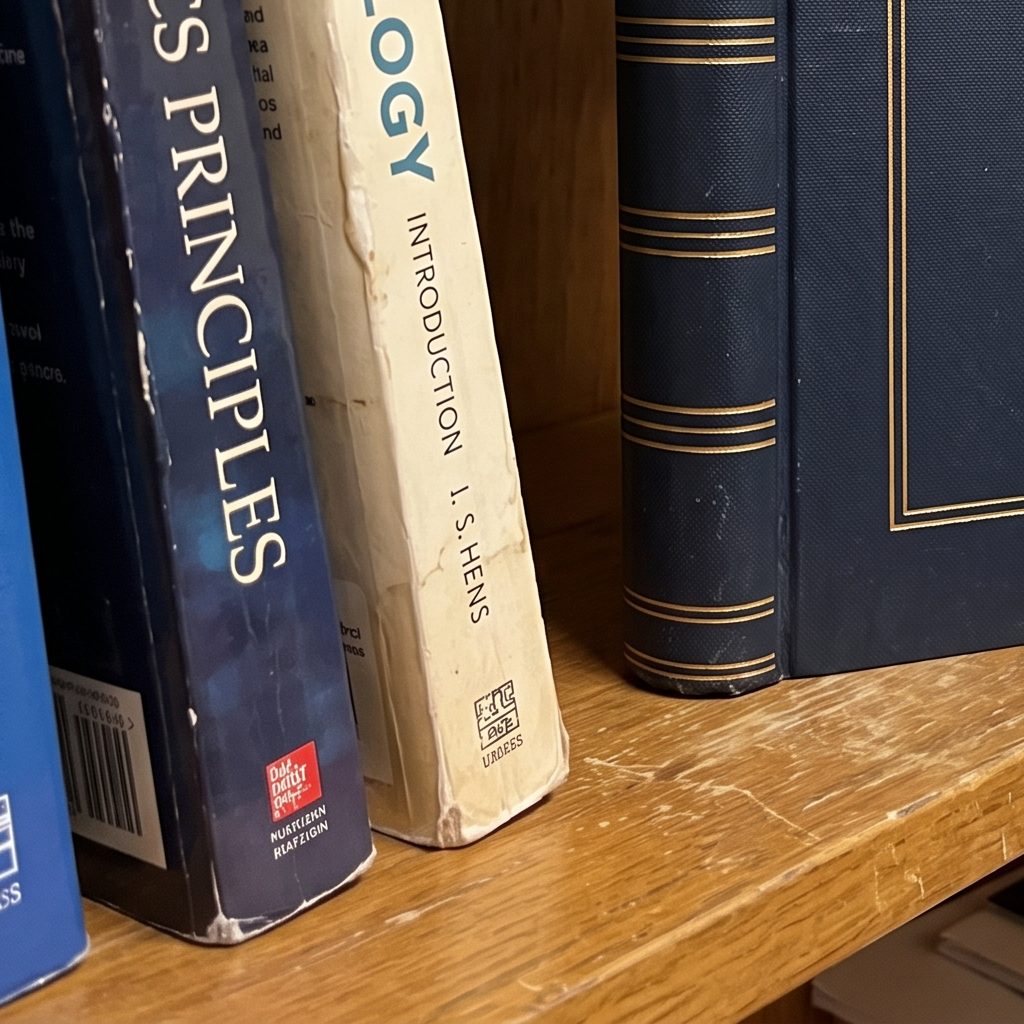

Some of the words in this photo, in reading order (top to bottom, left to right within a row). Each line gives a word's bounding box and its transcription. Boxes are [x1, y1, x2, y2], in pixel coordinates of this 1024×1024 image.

[163, 85, 287, 584] PRINCIPLES
[407, 212, 463, 456] INTRODUCTION
[460, 542, 490, 624] HENS
